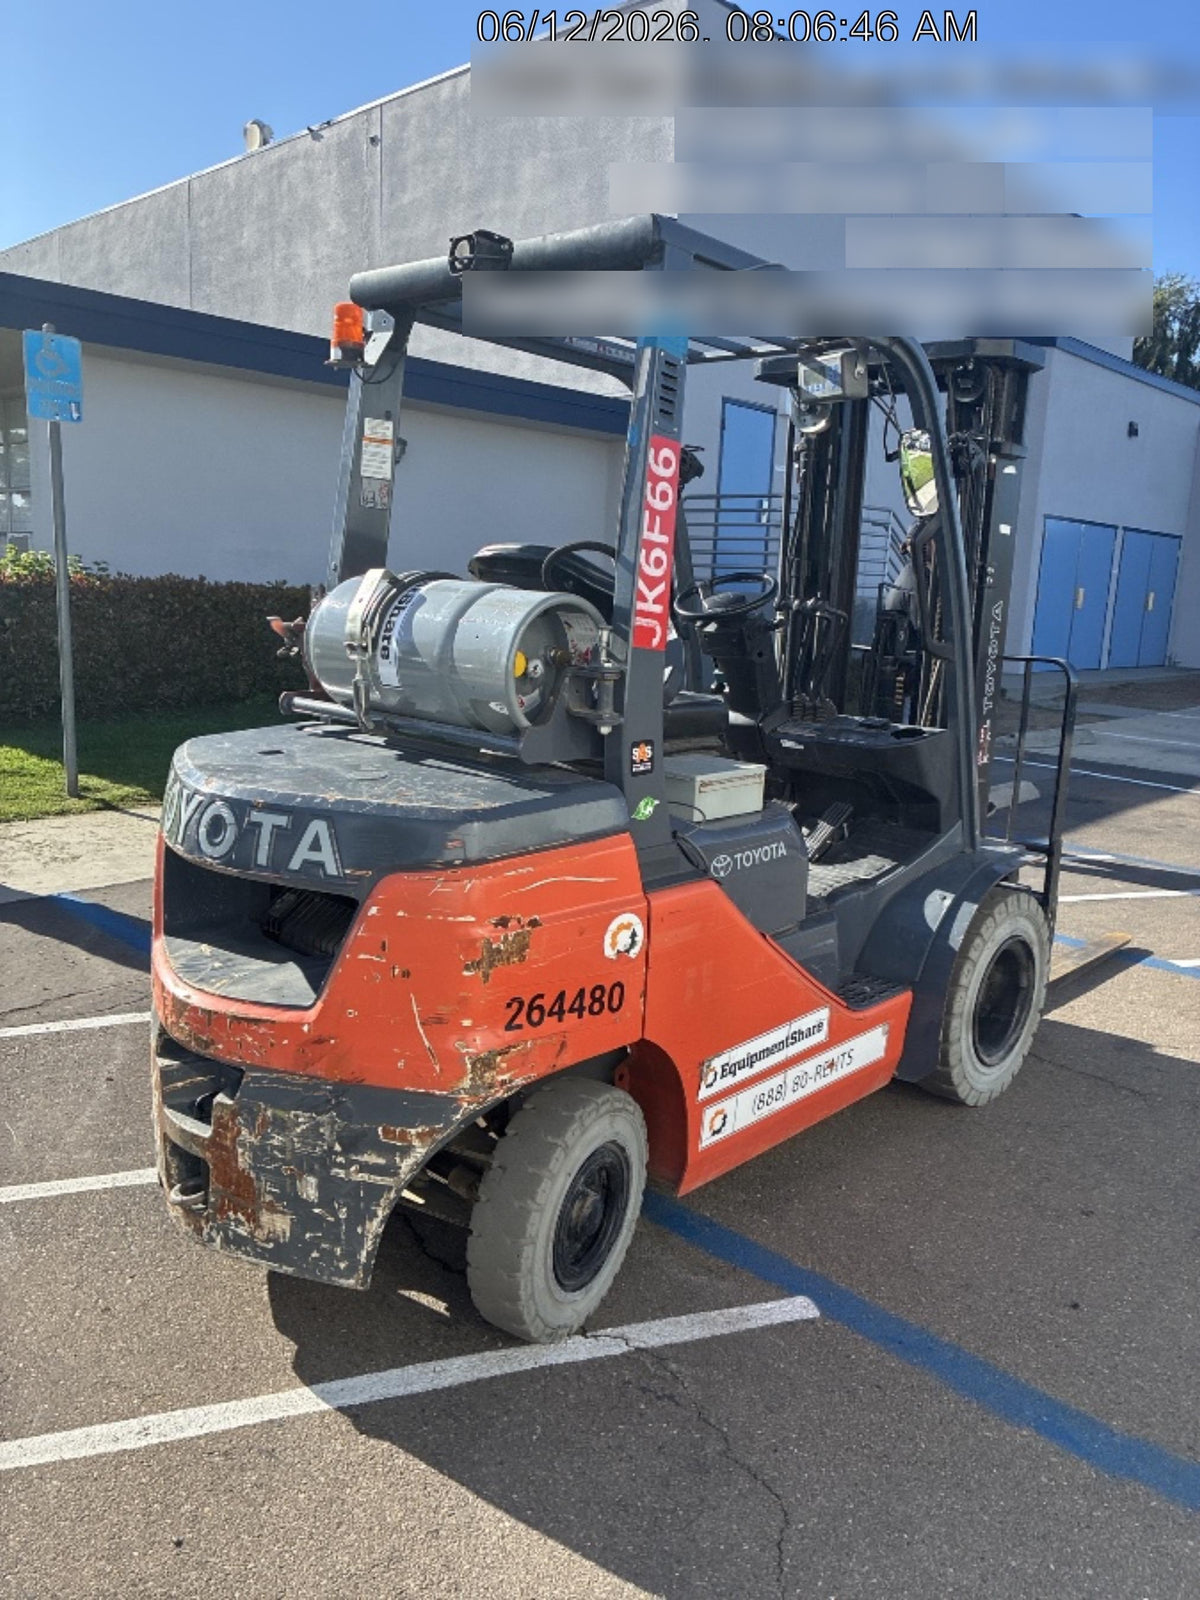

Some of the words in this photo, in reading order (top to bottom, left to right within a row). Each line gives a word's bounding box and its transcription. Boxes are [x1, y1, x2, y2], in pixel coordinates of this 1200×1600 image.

[634, 446, 679, 648] JK6F66
[982, 600, 1004, 716] TOYOTA
[734, 841, 787, 870] TOYOTA
[504, 980, 625, 1032] 264480
[719, 1019, 824, 1080] EquipmentShare
[751, 1084, 787, 1116] (888)
